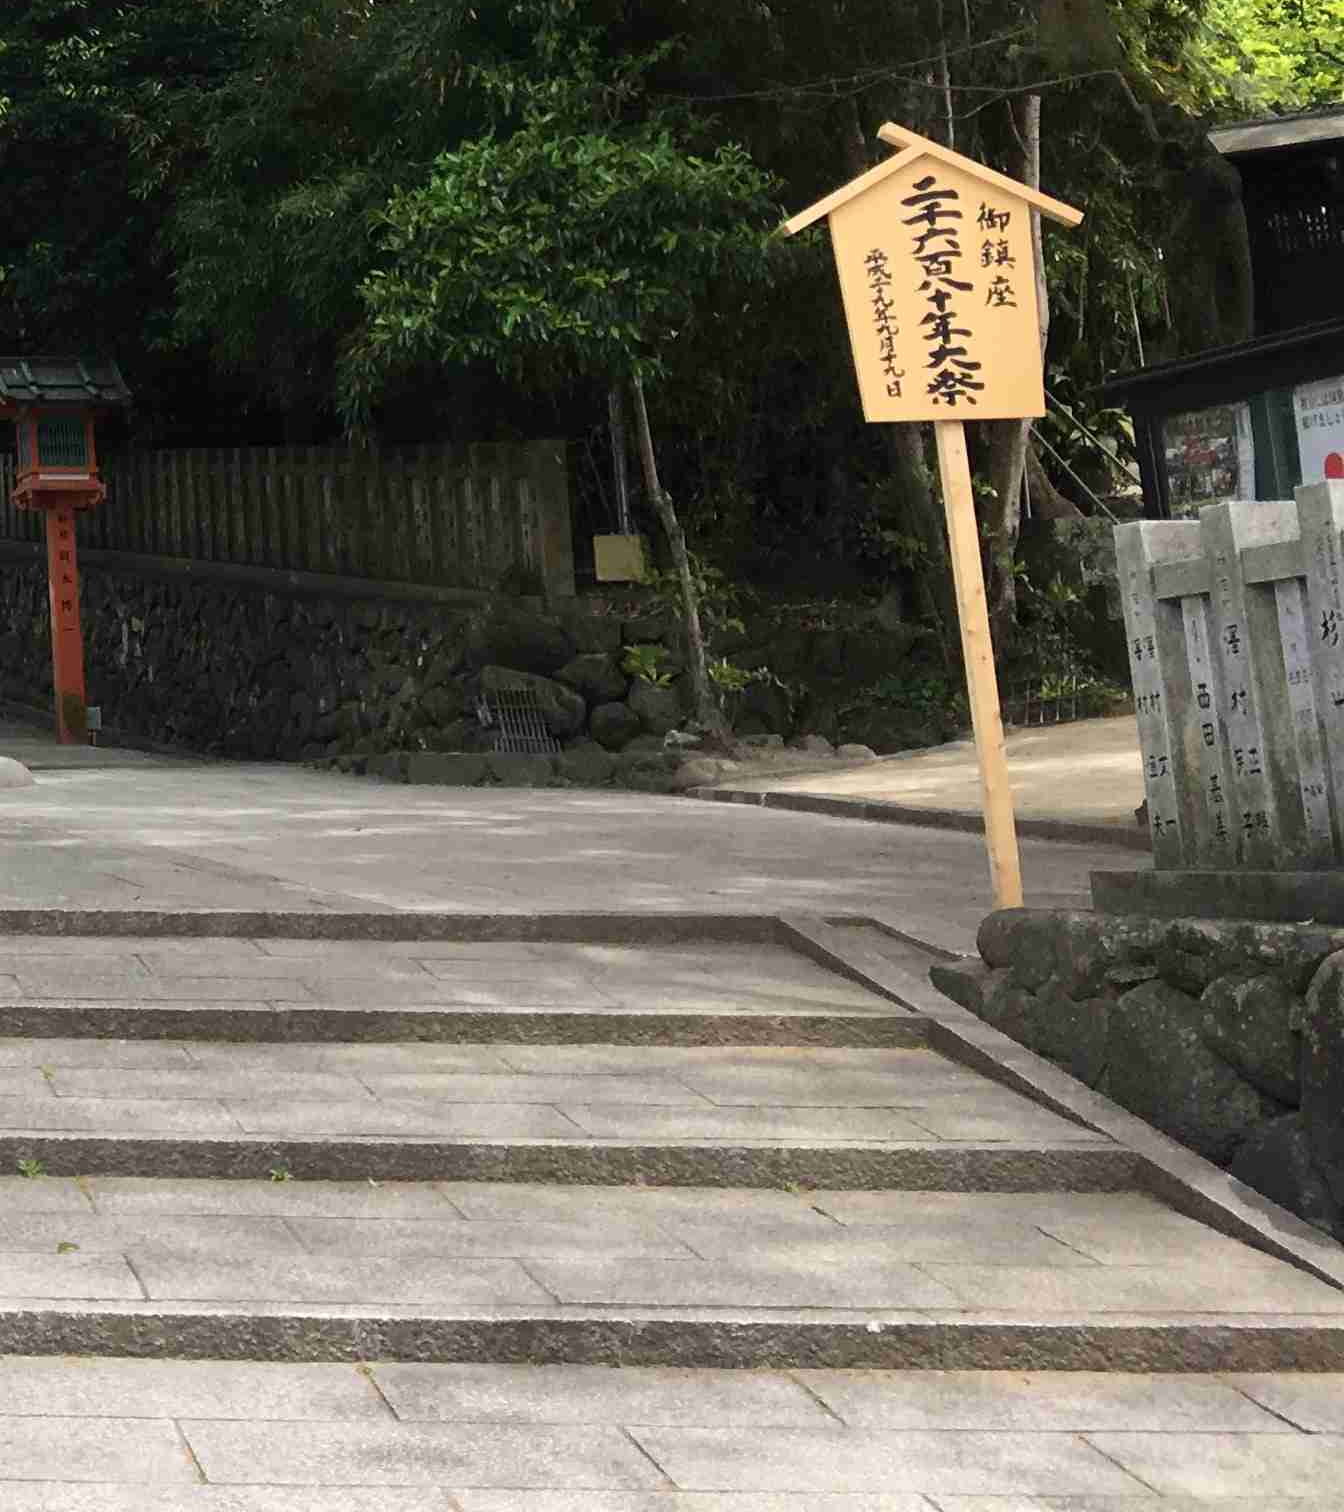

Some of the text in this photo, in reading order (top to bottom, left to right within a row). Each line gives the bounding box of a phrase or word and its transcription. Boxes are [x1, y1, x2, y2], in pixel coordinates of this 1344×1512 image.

[900, 176, 985, 406] 二千六百八十年大祭
[976, 202, 1017, 308] 御鎮座
